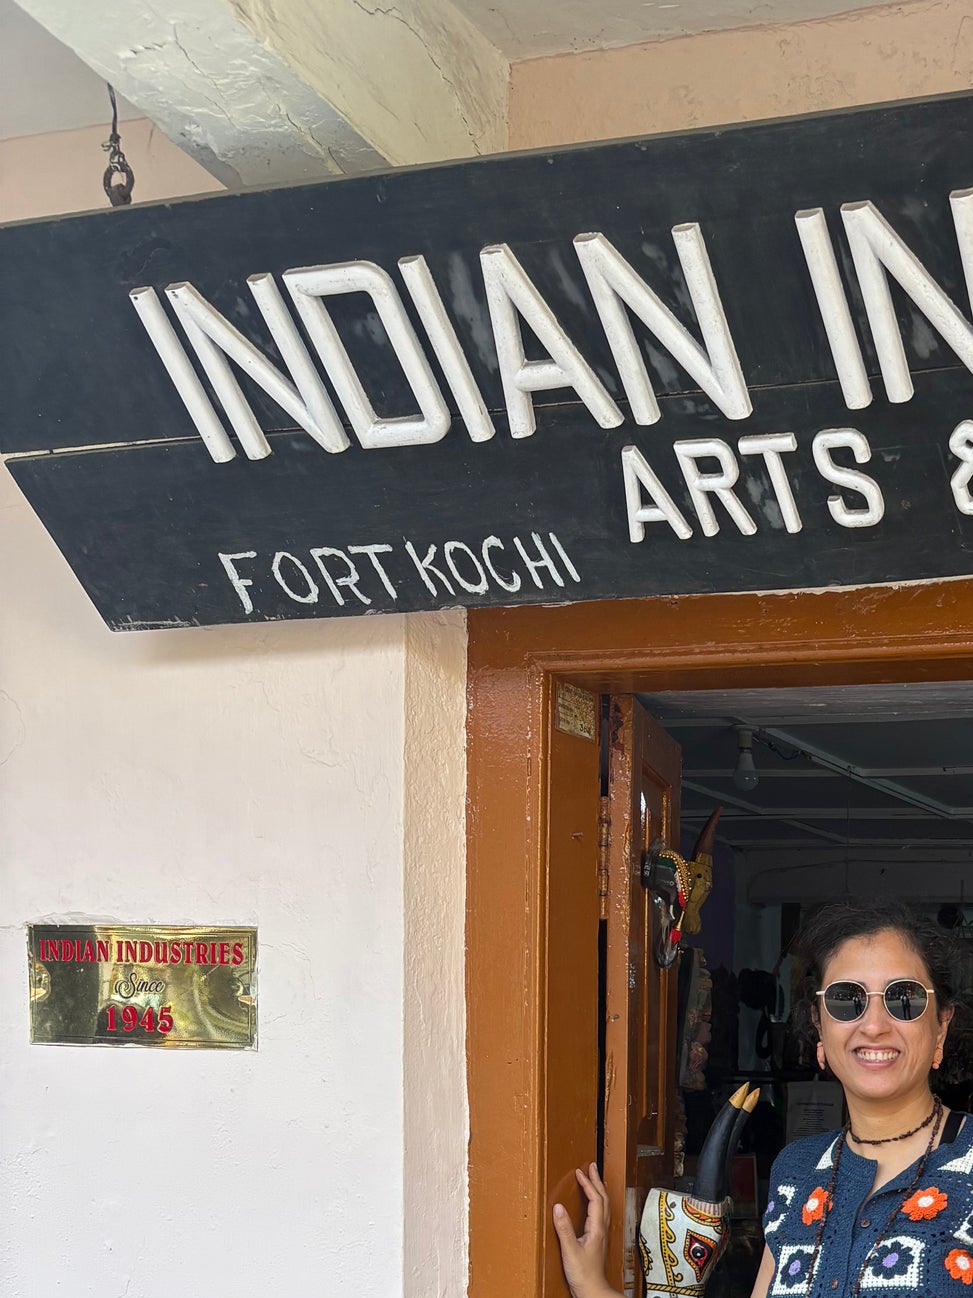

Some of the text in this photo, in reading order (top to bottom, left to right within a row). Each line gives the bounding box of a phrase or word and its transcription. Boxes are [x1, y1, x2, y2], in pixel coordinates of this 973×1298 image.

[129, 222, 753, 463] INDIAN
[622, 427, 886, 543] ARTS
[217, 532, 581, 615] FORT KOCHI
[39, 938, 244, 966] INDIAN INDUSTRIES
[114, 972, 165, 999] Since
[106, 1005, 174, 1034] 1945
